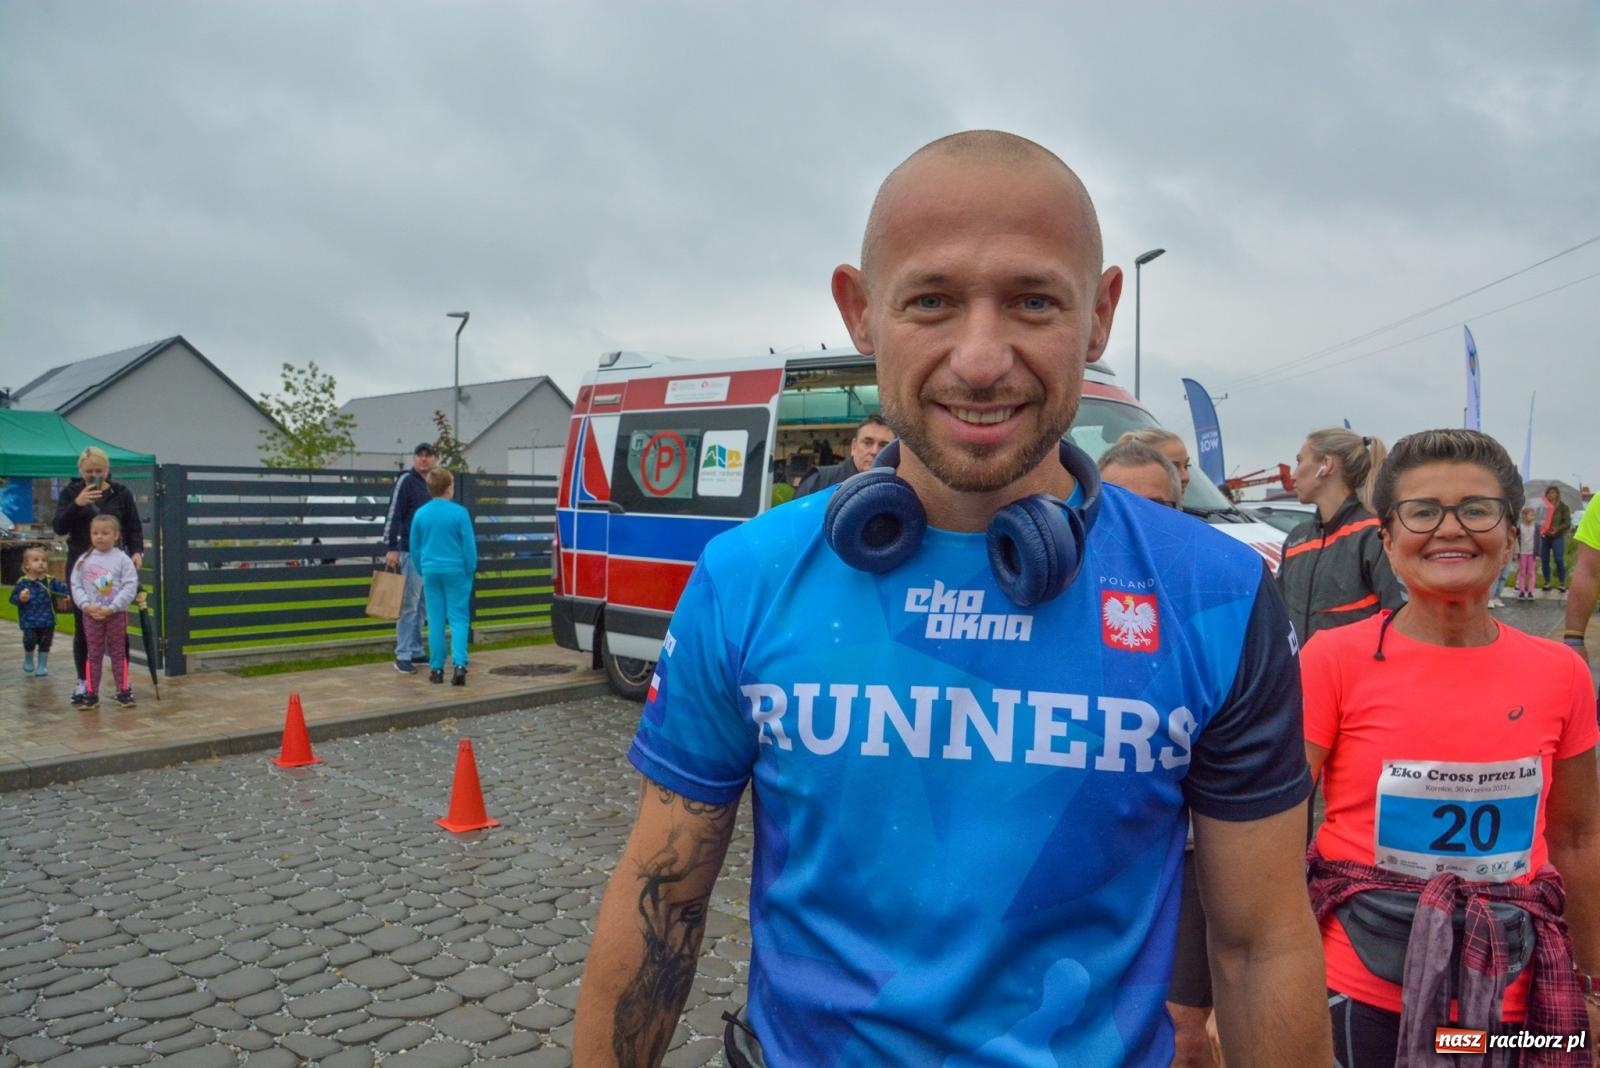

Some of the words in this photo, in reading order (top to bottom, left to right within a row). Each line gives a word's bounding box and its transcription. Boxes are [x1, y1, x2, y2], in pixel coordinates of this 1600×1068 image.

[1099, 576, 1155, 589] POLAND
[740, 682, 1198, 773] RUNNERS
[1390, 766, 1422, 779] Eko
[1427, 769, 1473, 782] Cross
[1478, 771, 1515, 785] przez
[1519, 766, 1536, 779] Las
[1429, 803, 1500, 852] 20
